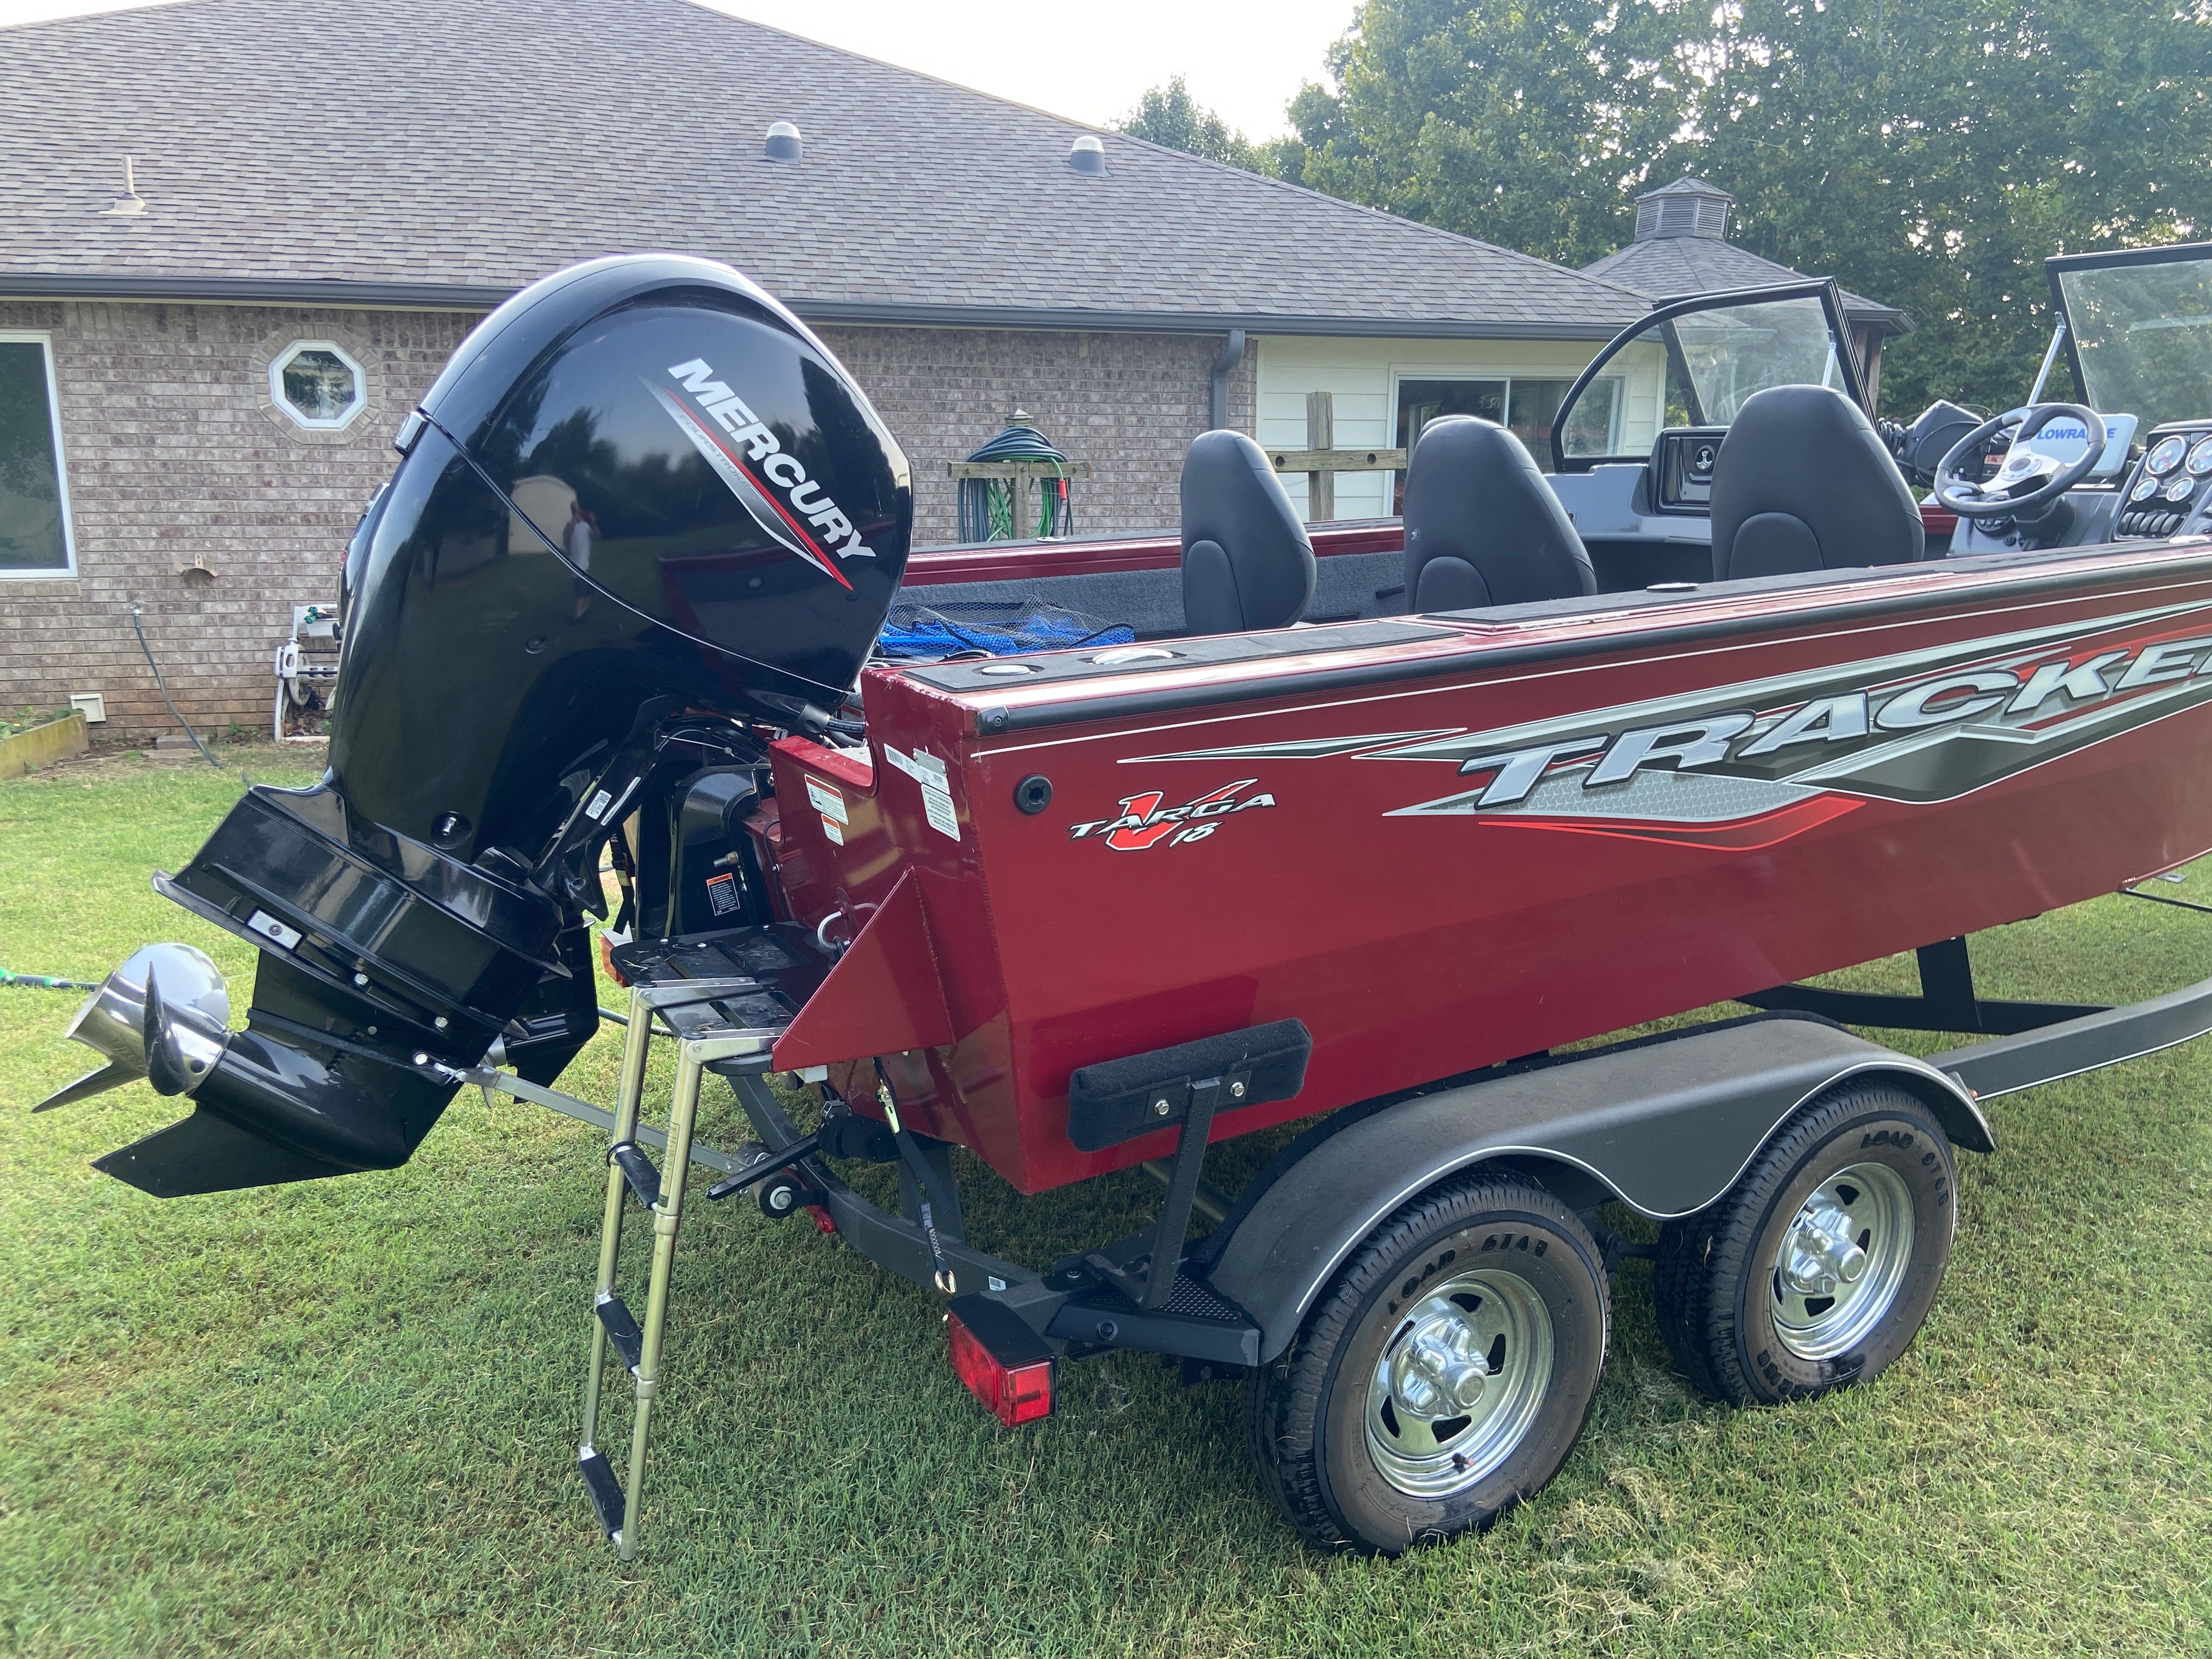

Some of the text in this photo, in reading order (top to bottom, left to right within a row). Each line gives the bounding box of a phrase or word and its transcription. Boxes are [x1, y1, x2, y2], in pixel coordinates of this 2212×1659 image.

[667, 357, 877, 559] MERCURY
[2036, 428, 2117, 440] LOWRAE
[1458, 635, 2212, 809] TRACKE
[1069, 793, 1276, 840] TARGA
[1168, 821, 1224, 848] 18
[1860, 1130, 1949, 1207] LOAD STAR
[1387, 1232, 1548, 1316] LOAD STAR
